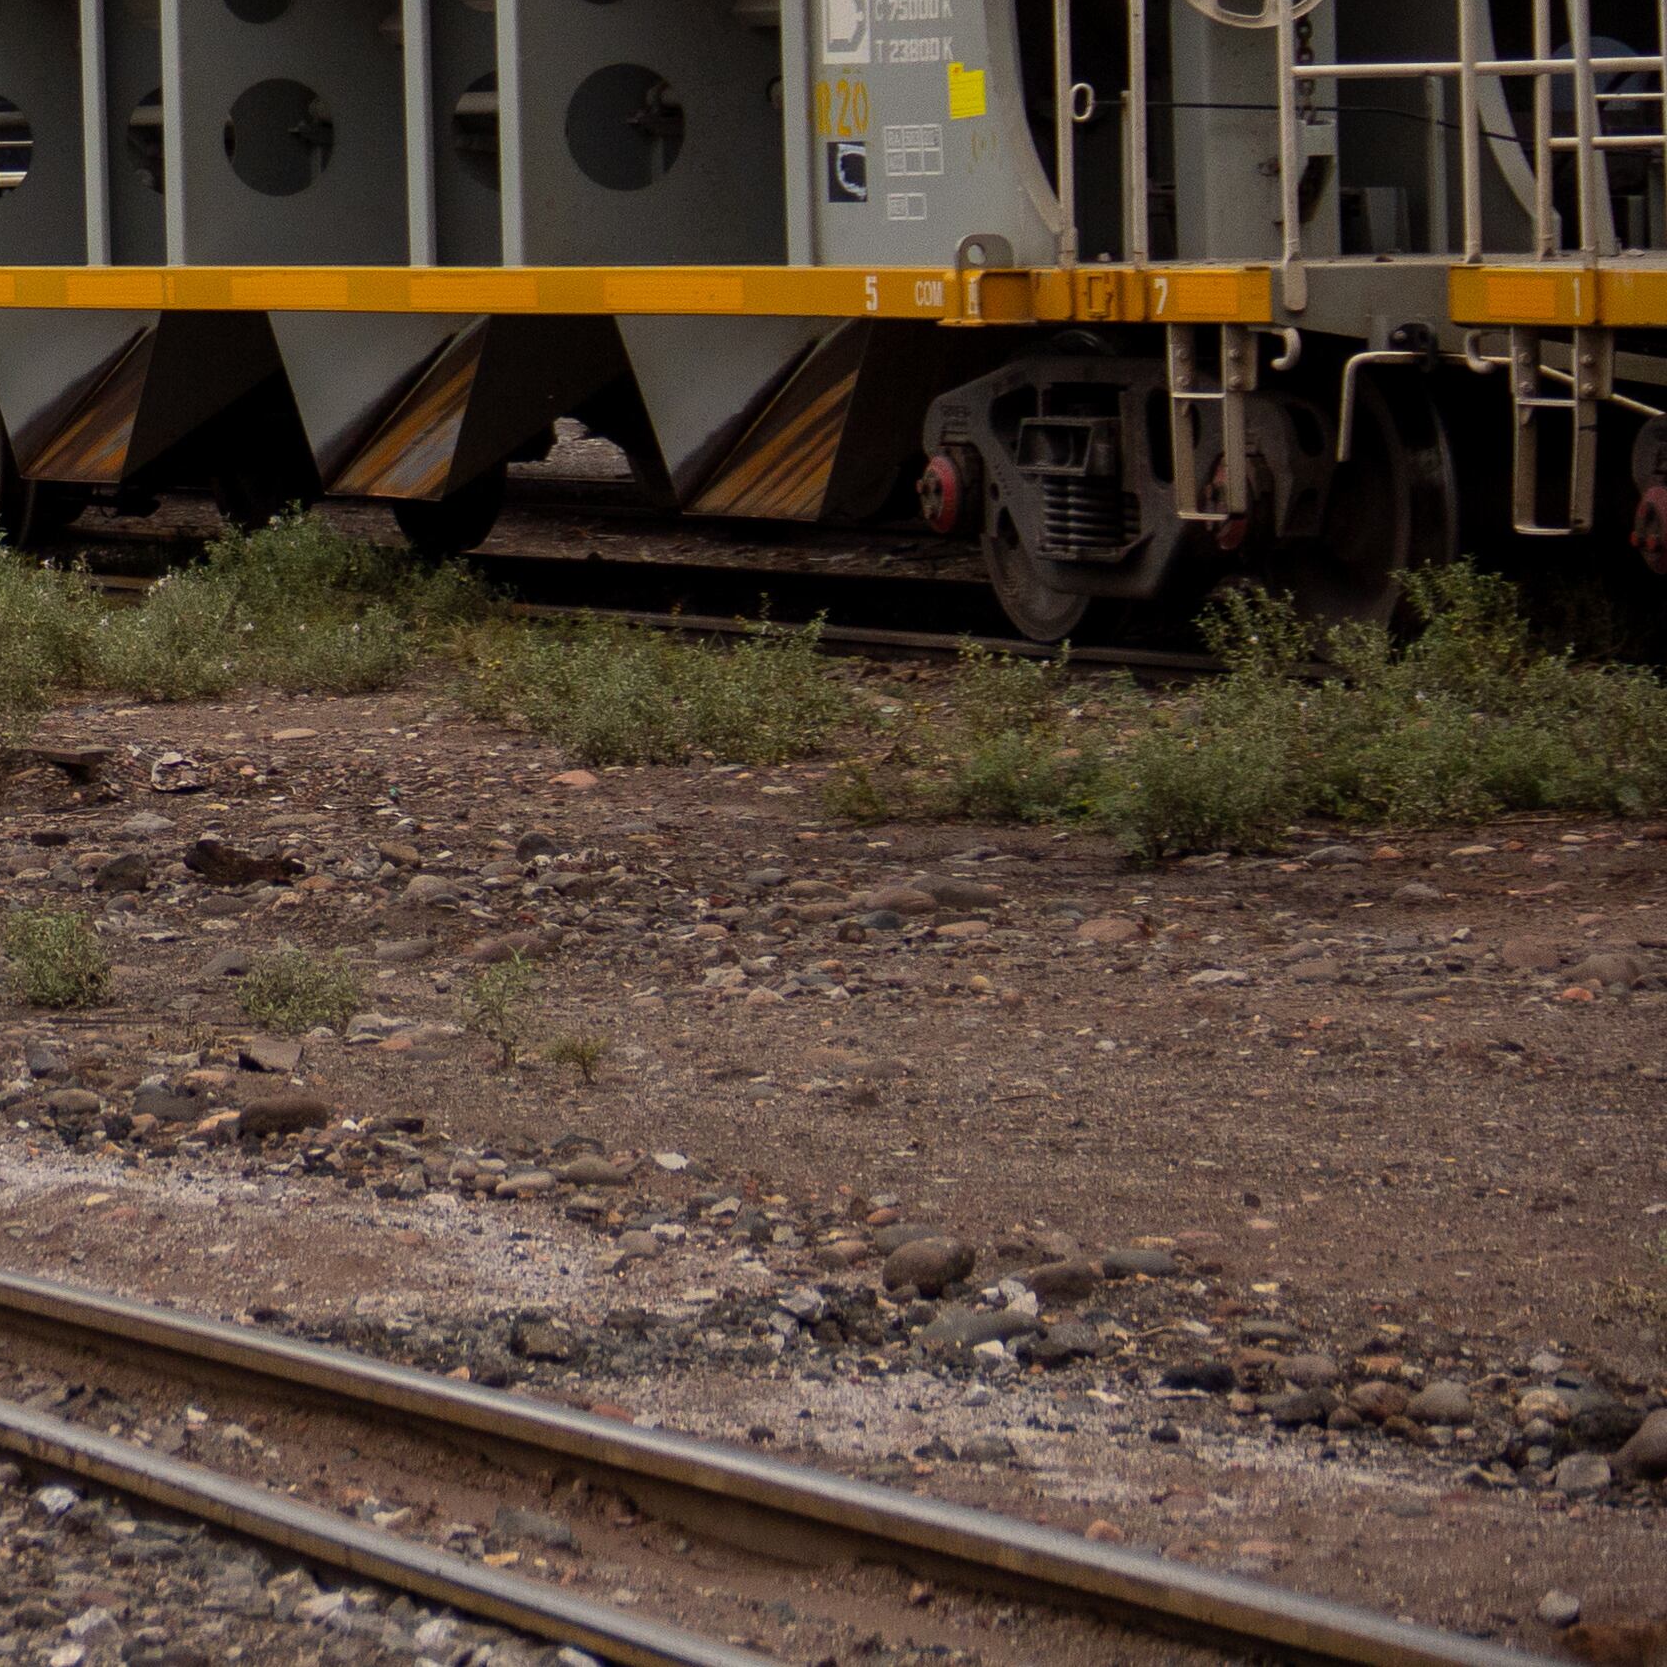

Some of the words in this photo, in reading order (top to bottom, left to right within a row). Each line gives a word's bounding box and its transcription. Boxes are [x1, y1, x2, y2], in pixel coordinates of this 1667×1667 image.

[889, 38, 941, 64] 23800
[942, 36, 955, 61] K
[865, 275, 879, 311] 5
[1153, 278, 1169, 315] 7
